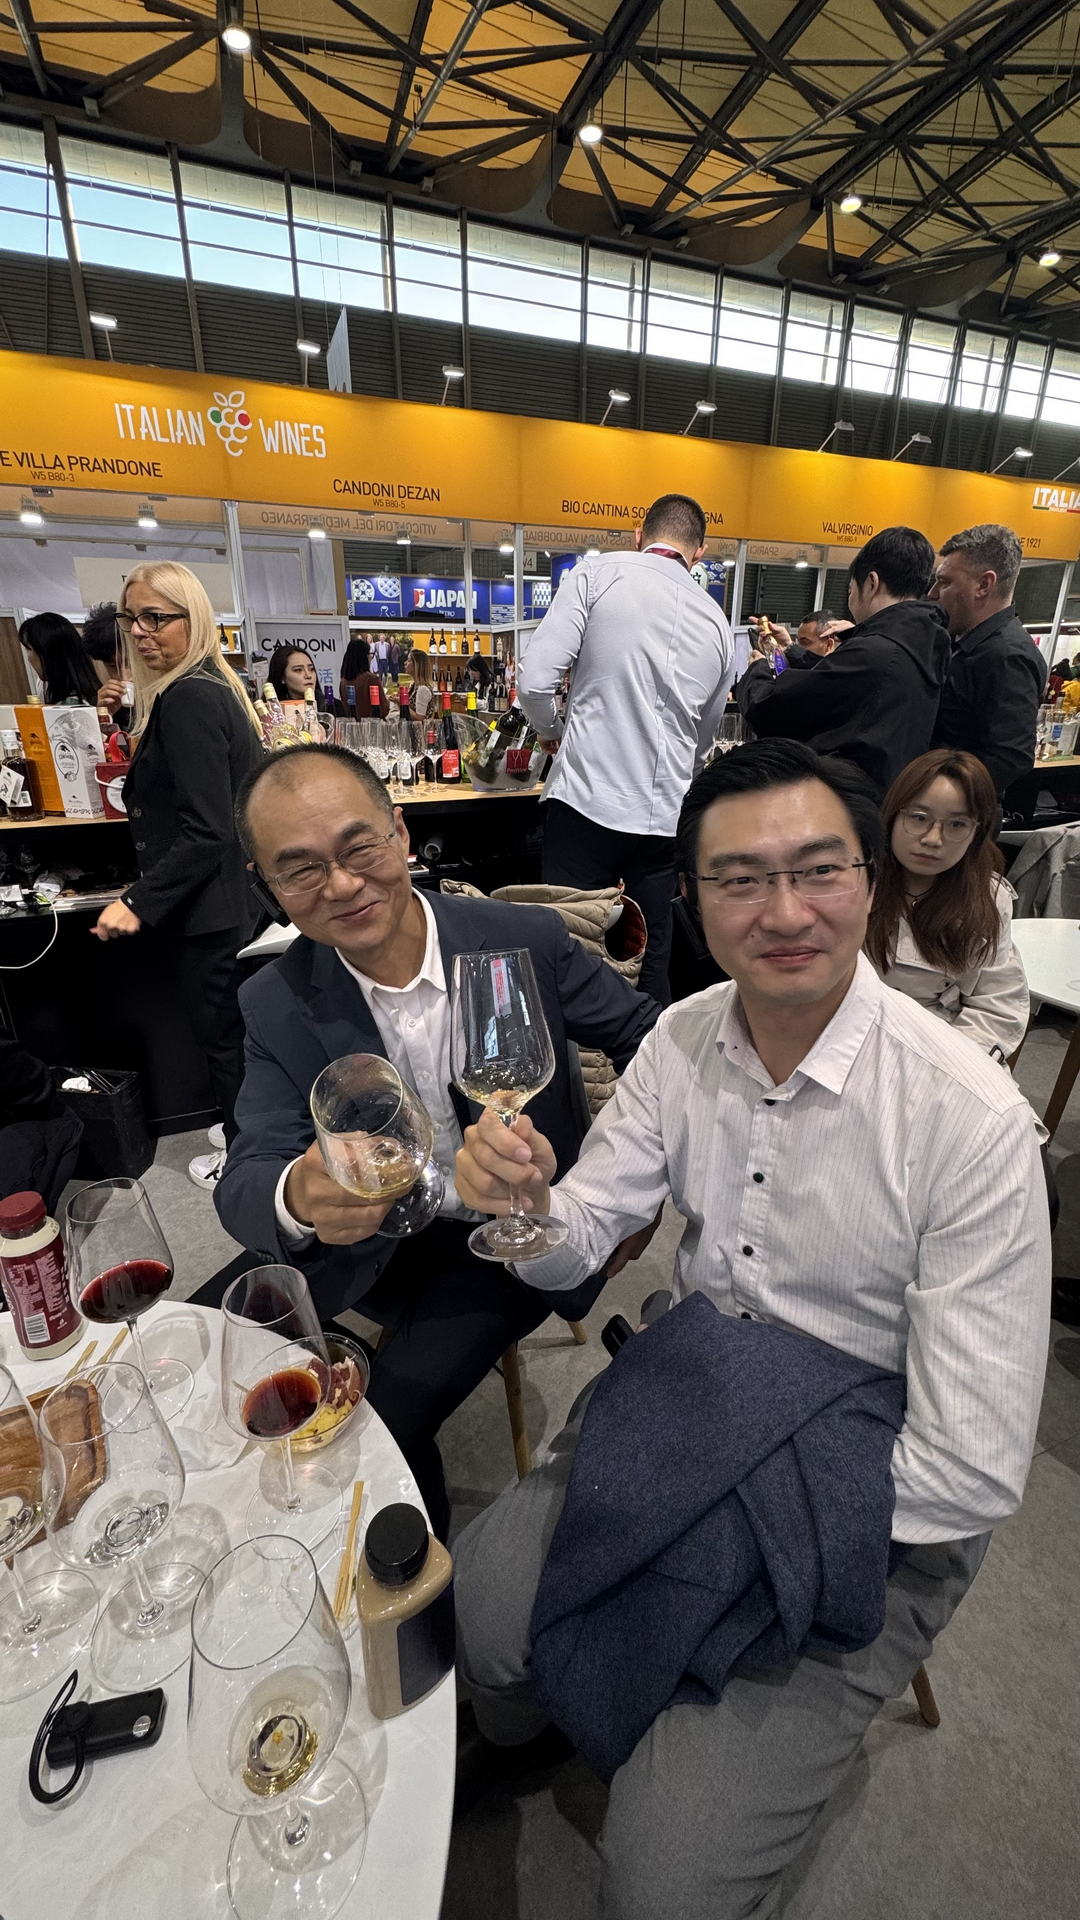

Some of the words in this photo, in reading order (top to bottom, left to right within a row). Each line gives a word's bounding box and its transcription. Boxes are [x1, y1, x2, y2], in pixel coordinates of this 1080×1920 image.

[114, 403, 206, 446] ITALIAN
[258, 418, 326, 458] WINES
[13, 451, 65, 470] VILLA
[67, 455, 163, 478] PRANDONE
[31, 470, 46, 480] W5
[48, 471, 75, 482] B80-3
[333, 479, 395, 497] CANDONI
[397, 484, 441, 501] DEZAN
[373, 498, 384, 508] W5
[385, 499, 406, 509] B80-5
[561, 499, 581, 513] BIO
[582, 501, 630, 518] CANTINA
[822, 521, 874, 537] VALVIRGINIO
[261, 638, 336, 652] CANDONI
